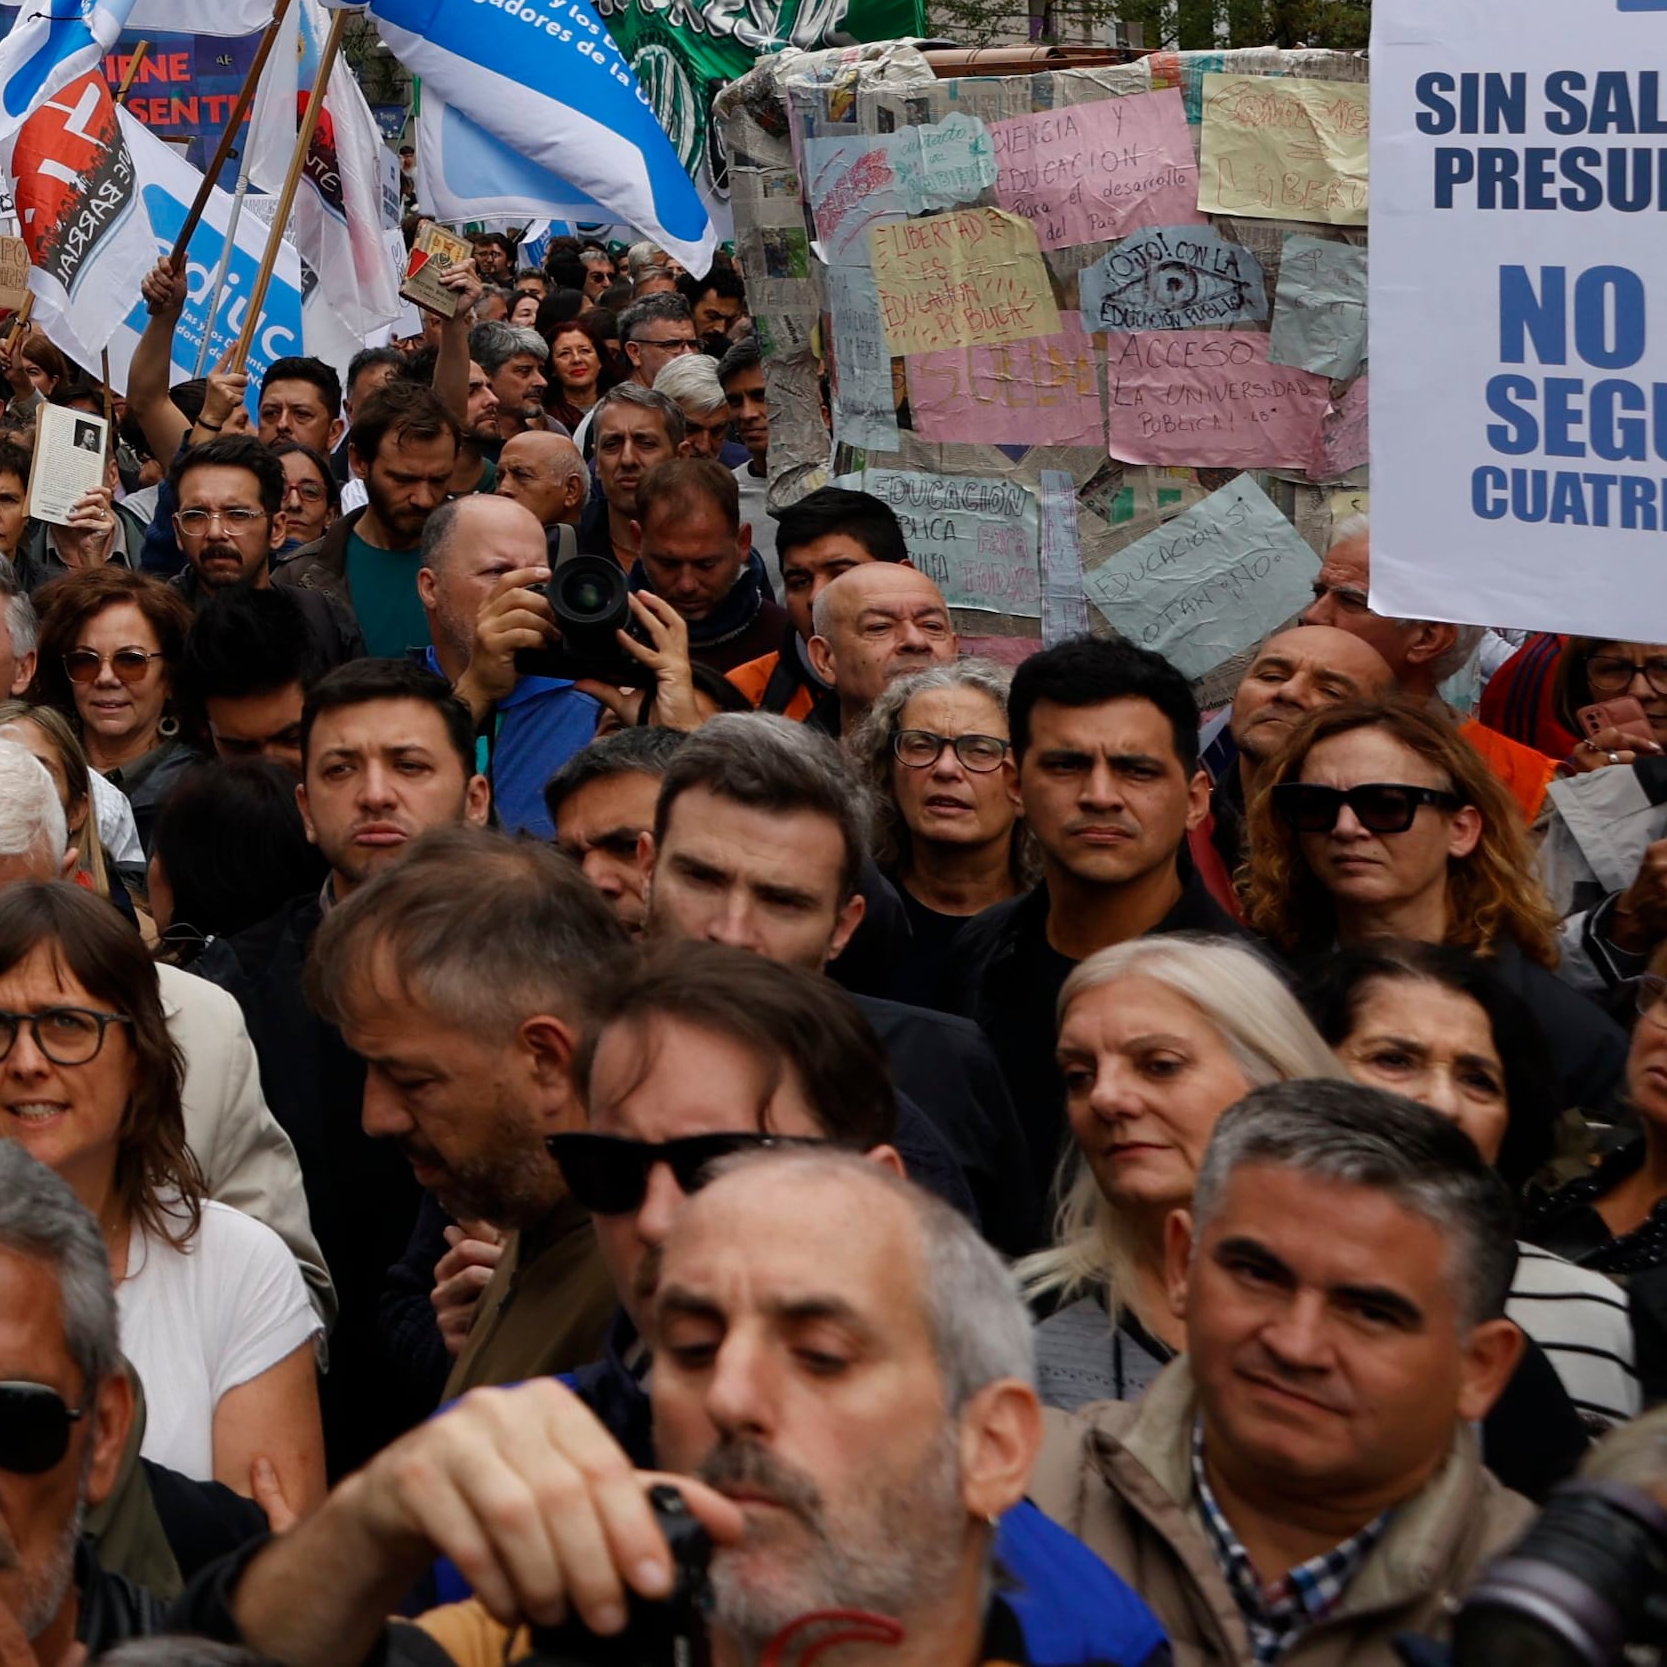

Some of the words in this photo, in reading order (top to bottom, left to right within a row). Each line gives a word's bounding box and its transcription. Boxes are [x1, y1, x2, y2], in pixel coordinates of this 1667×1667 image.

[569, 4, 600, 35] los
[100, 52, 191, 83] IENE
[576, 39, 607, 65] de
[609, 61, 631, 87] la
[1415, 71, 1527, 136] SIN
[1544, 70, 1667, 136] SAL
[991, 115, 1079, 154] CIENCIA
[1112, 105, 1123, 137] Y
[1069, 187, 1083, 205] el
[1103, 167, 1186, 198] desarrollo
[1434, 146, 1667, 213] PRESU
[892, 210, 986, 258] LIBERTAD
[1046, 217, 1067, 241] del
[923, 258, 948, 281] ES
[1175, 241, 1209, 266] CON
[1215, 248, 1242, 278] LA
[1499, 264, 1646, 370] NO
[1118, 333, 1255, 369] ACCESO
[1113, 376, 1144, 408] LA
[1471, 465, 1667, 533] CUATR
[1142, 589, 1214, 644] OTAN
